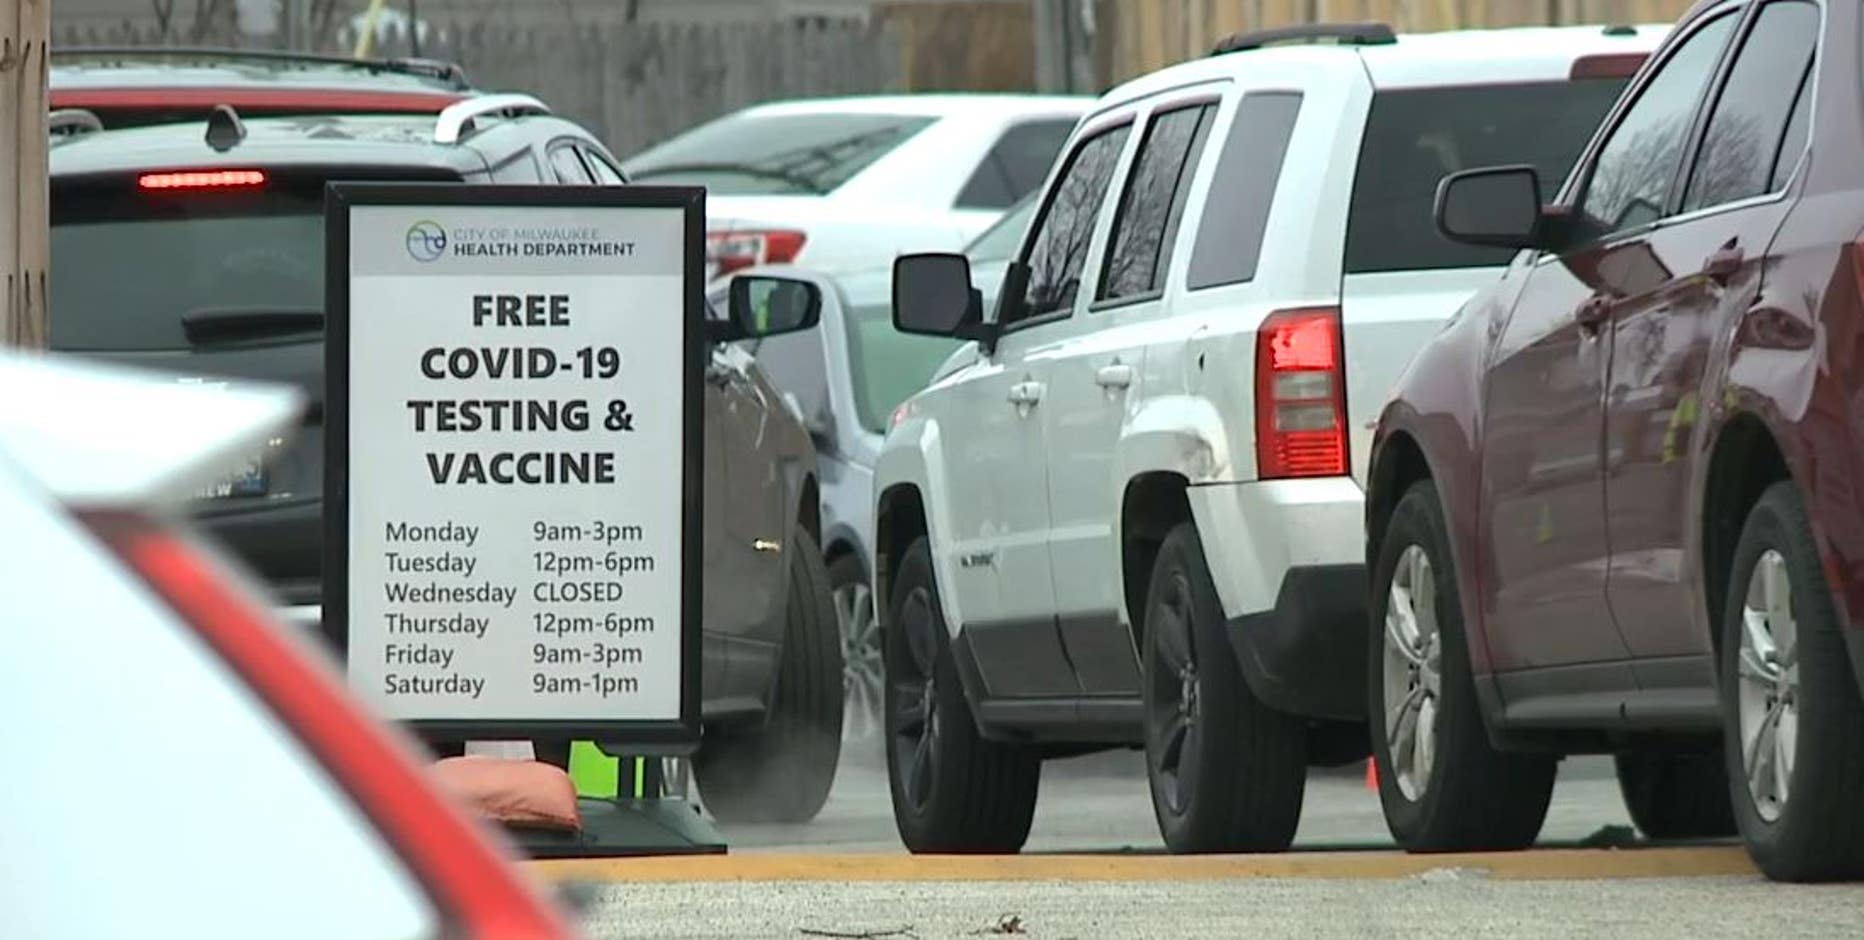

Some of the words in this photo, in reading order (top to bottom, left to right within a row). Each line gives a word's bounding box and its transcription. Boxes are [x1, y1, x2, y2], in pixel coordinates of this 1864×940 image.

[453, 227, 485, 241] CITY
[488, 227, 509, 241] OF
[513, 227, 600, 241] MILWAUKEE
[453, 242, 519, 257] HEALTH
[523, 242, 635, 257] DEPARTMENT
[473, 295, 571, 327] FREE
[420, 346, 621, 380] COVID-19
[406, 400, 590, 432] TESTING
[603, 399, 634, 432] &
[426, 452, 616, 485] VACCINE
[385, 521, 479, 547] Monday
[533, 521, 643, 547] 9am-3pm
[385, 552, 477, 577] Tuesday
[534, 552, 655, 577] 12pm-6pm
[385, 582, 517, 608] Wednesday
[533, 581, 623, 603] CLOSED
[385, 612, 490, 639] Thursday
[534, 612, 655, 638] 12pm-6pm
[385, 643, 455, 669] Friday
[533, 643, 643, 669] 9am-3pm
[385, 673, 485, 700] Saturday
[533, 673, 639, 699] 9am-1pm
